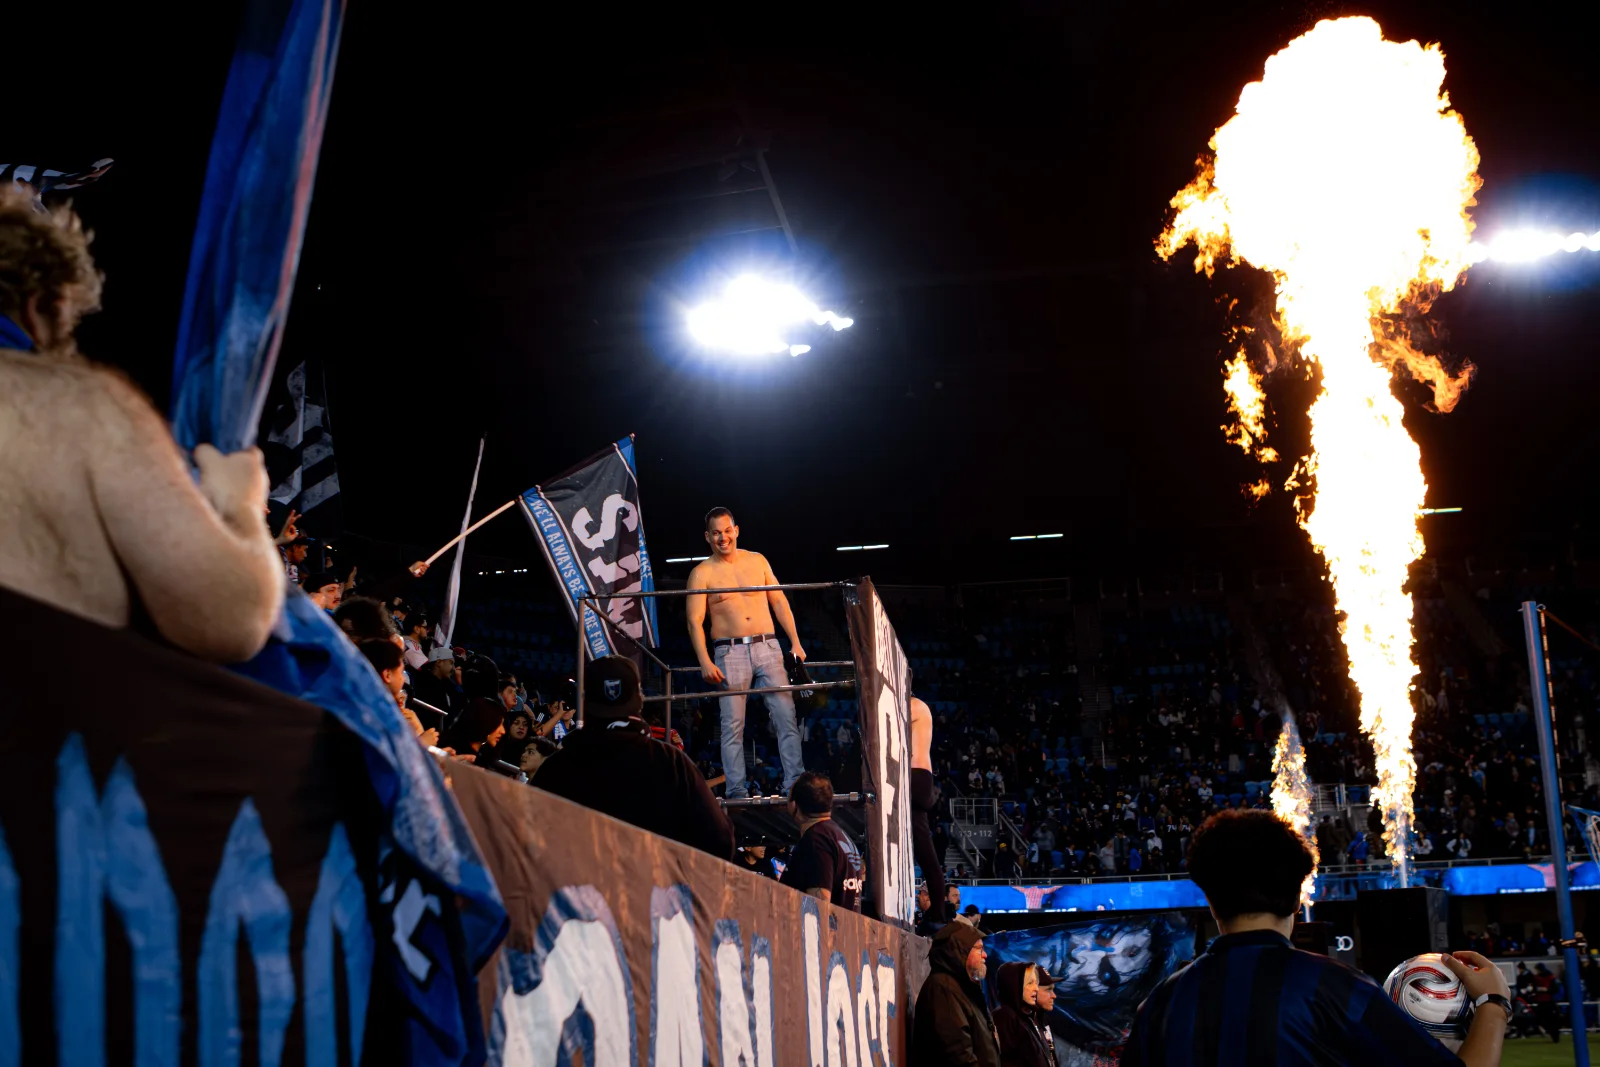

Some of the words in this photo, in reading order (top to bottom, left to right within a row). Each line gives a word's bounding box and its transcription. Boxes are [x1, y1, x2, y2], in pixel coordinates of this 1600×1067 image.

[530, 499, 557, 533] WE'LL
[546, 532, 577, 579] ALWAYS
[569, 578, 584, 597] BE
[589, 631, 607, 653] FOR
[979, 829, 993, 838] 112
